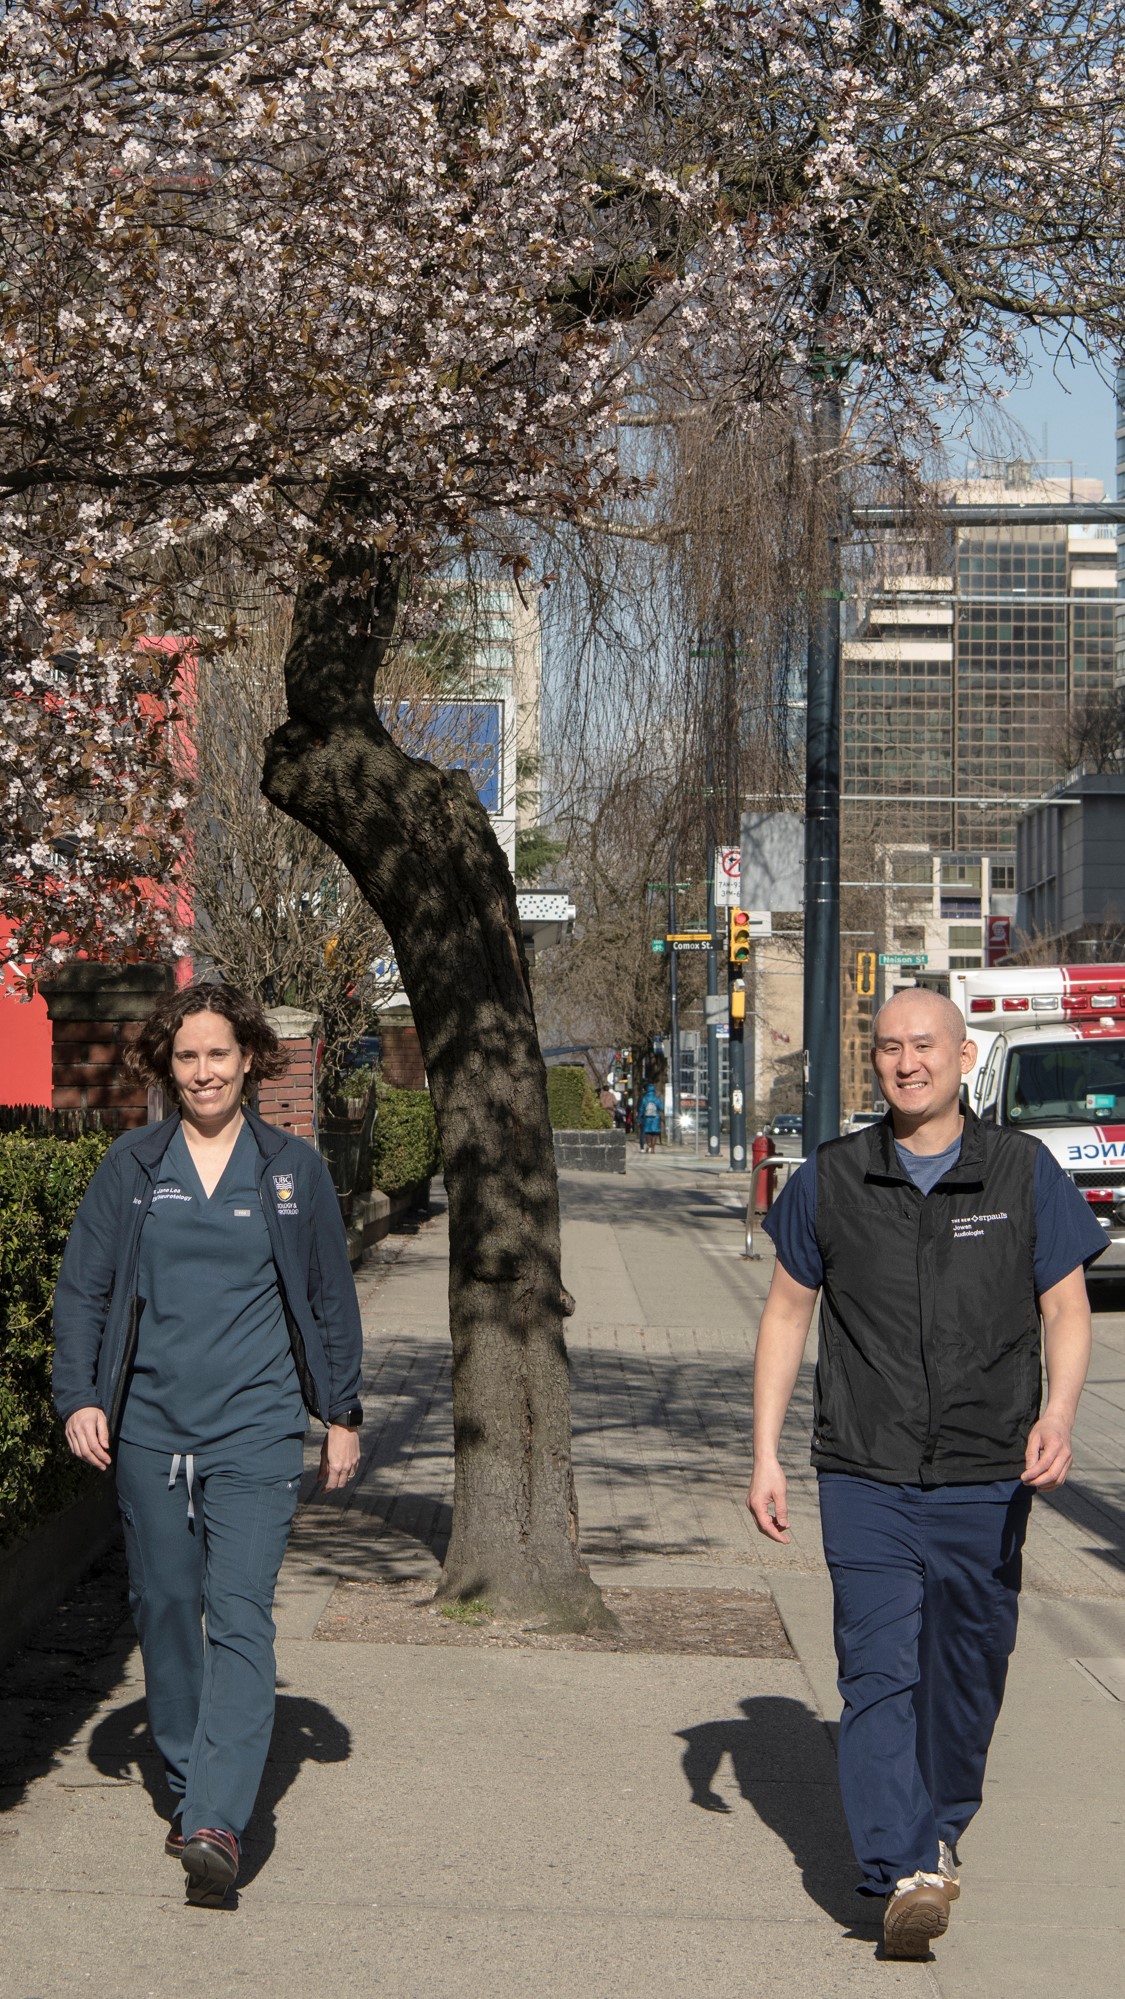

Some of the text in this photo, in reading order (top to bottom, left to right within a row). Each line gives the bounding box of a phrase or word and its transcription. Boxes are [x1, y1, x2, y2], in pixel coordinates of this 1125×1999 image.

[672, 941, 713, 950] Comox St.
[275, 1176, 291, 1184] UBC
[954, 1230, 984, 1238] Audiologist
